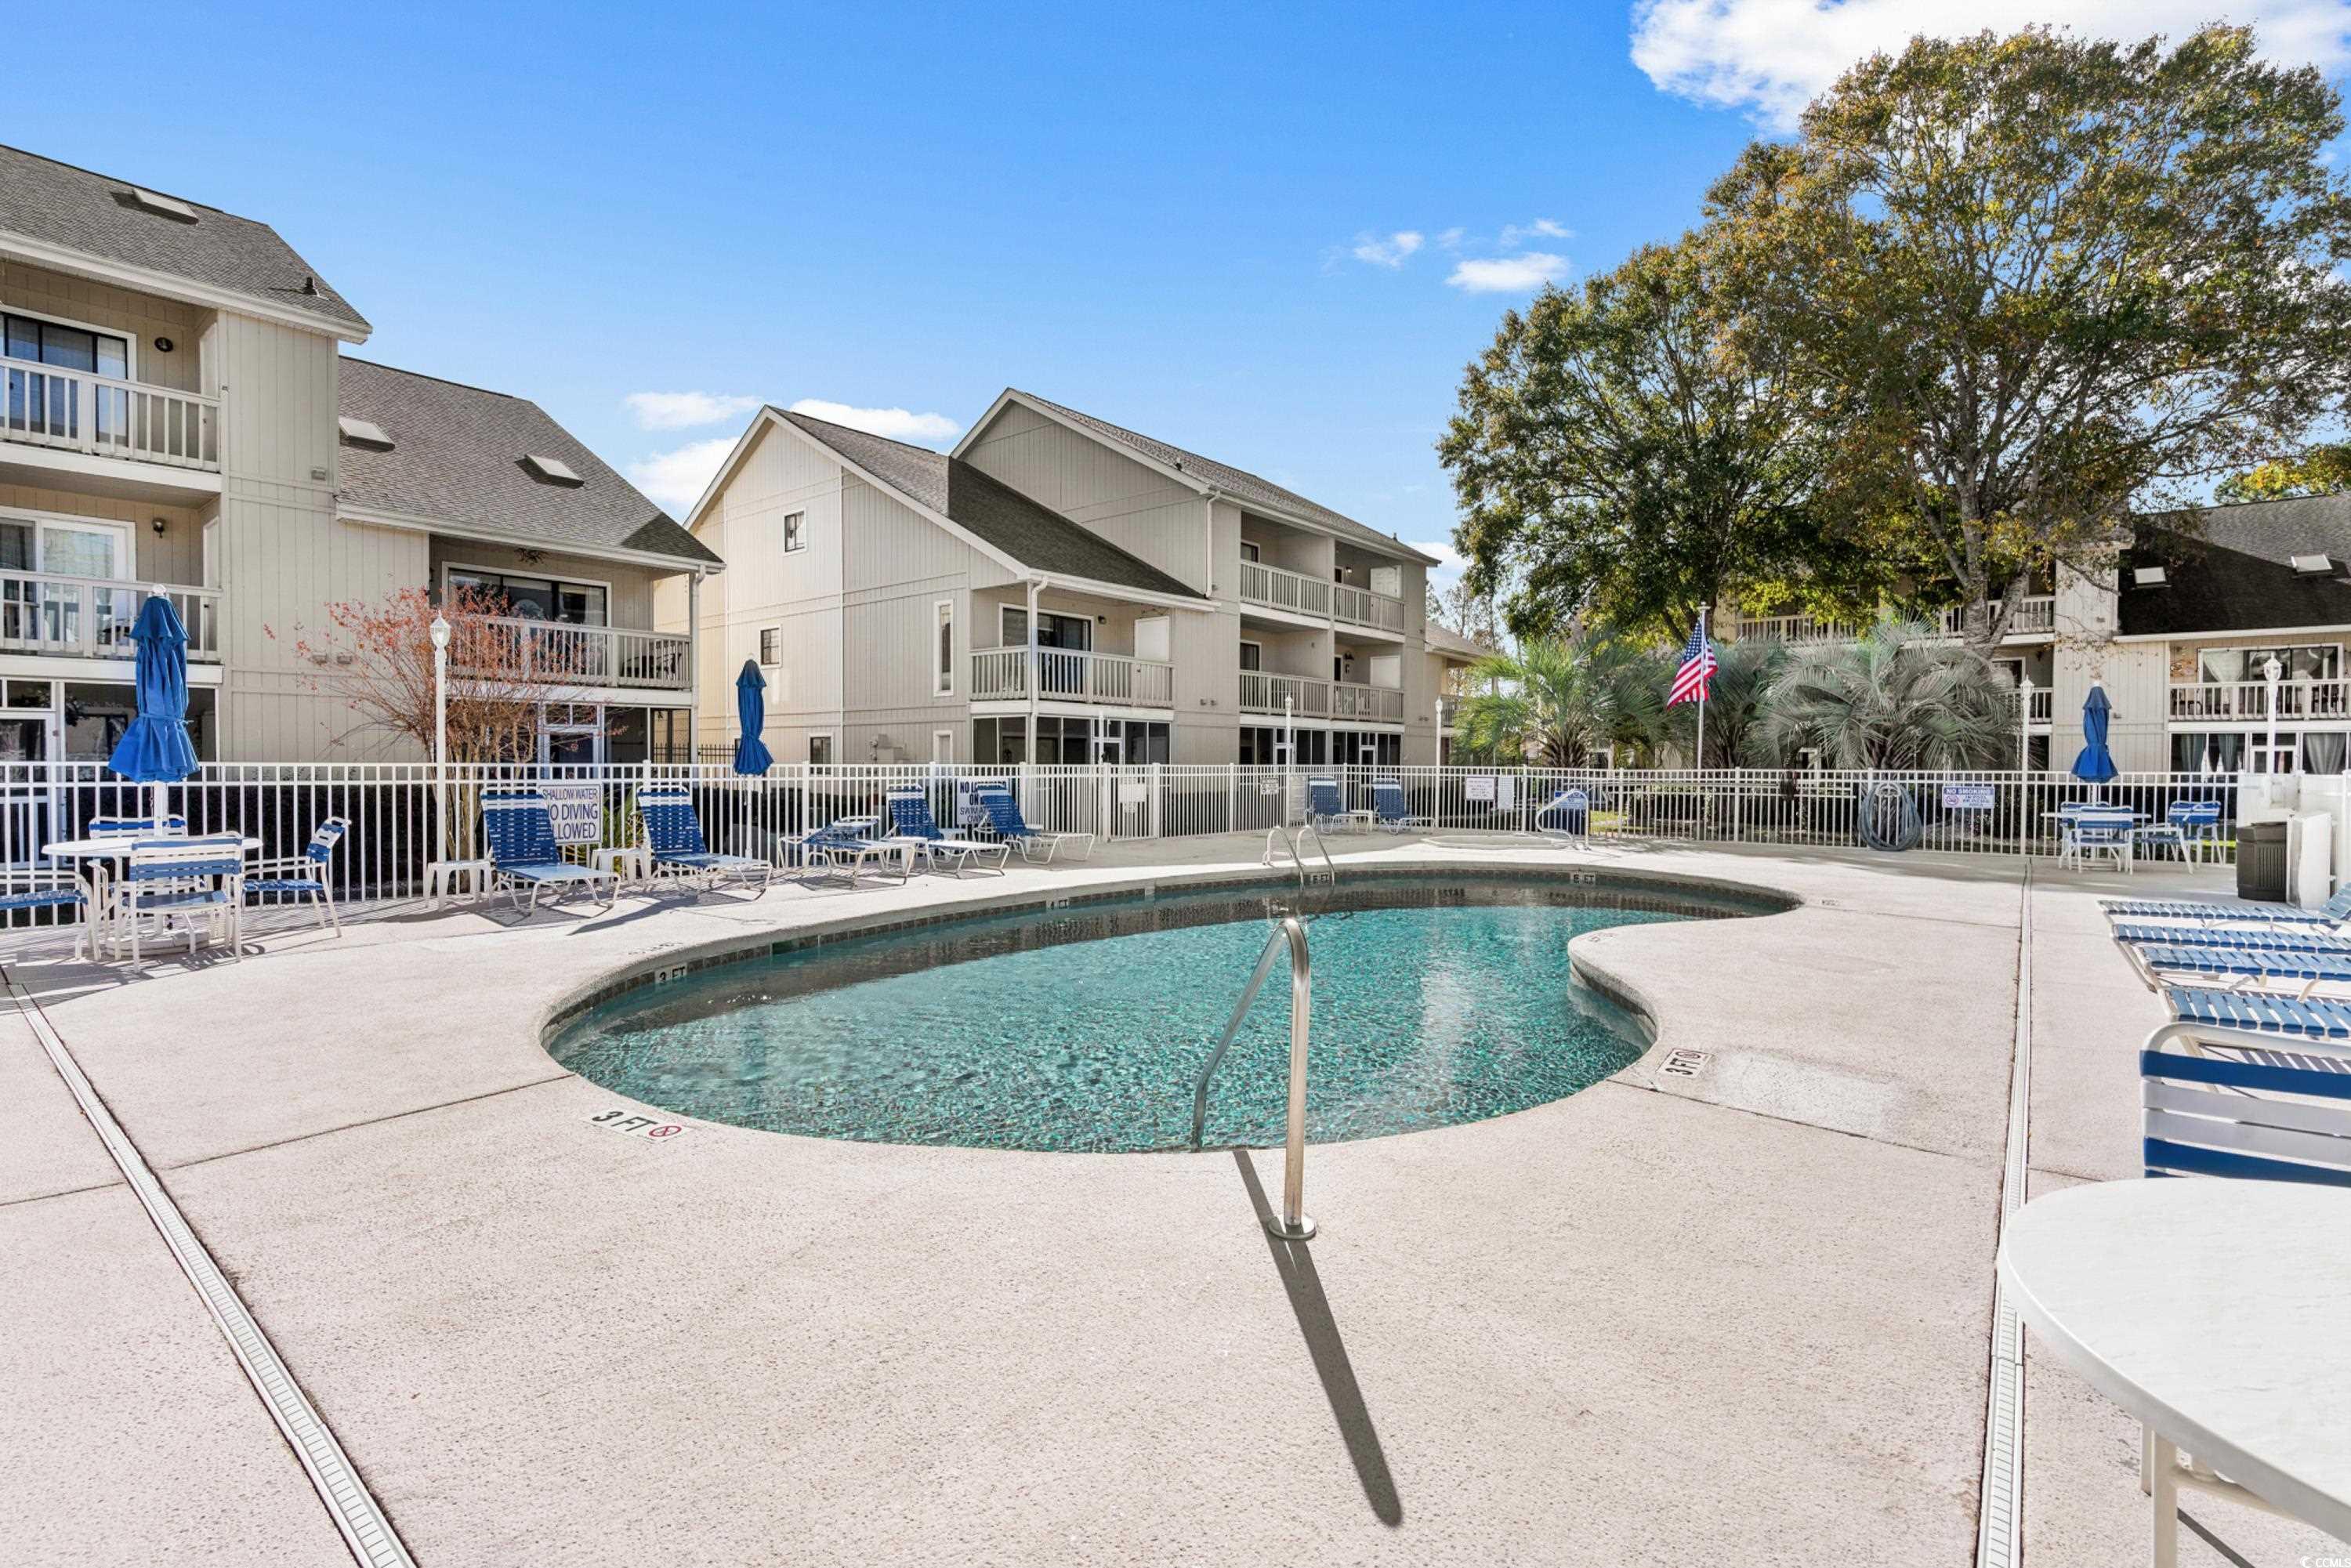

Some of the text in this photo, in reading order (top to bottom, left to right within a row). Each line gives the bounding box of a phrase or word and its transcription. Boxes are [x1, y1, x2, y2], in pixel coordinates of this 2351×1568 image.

[542, 788, 598, 800] SHALLOW WATER
[960, 781, 969, 793] NO
[547, 804, 598, 820] O DIVING
[552, 822, 596, 840] LLOWED
[592, 1110, 658, 1132] 3 FT
